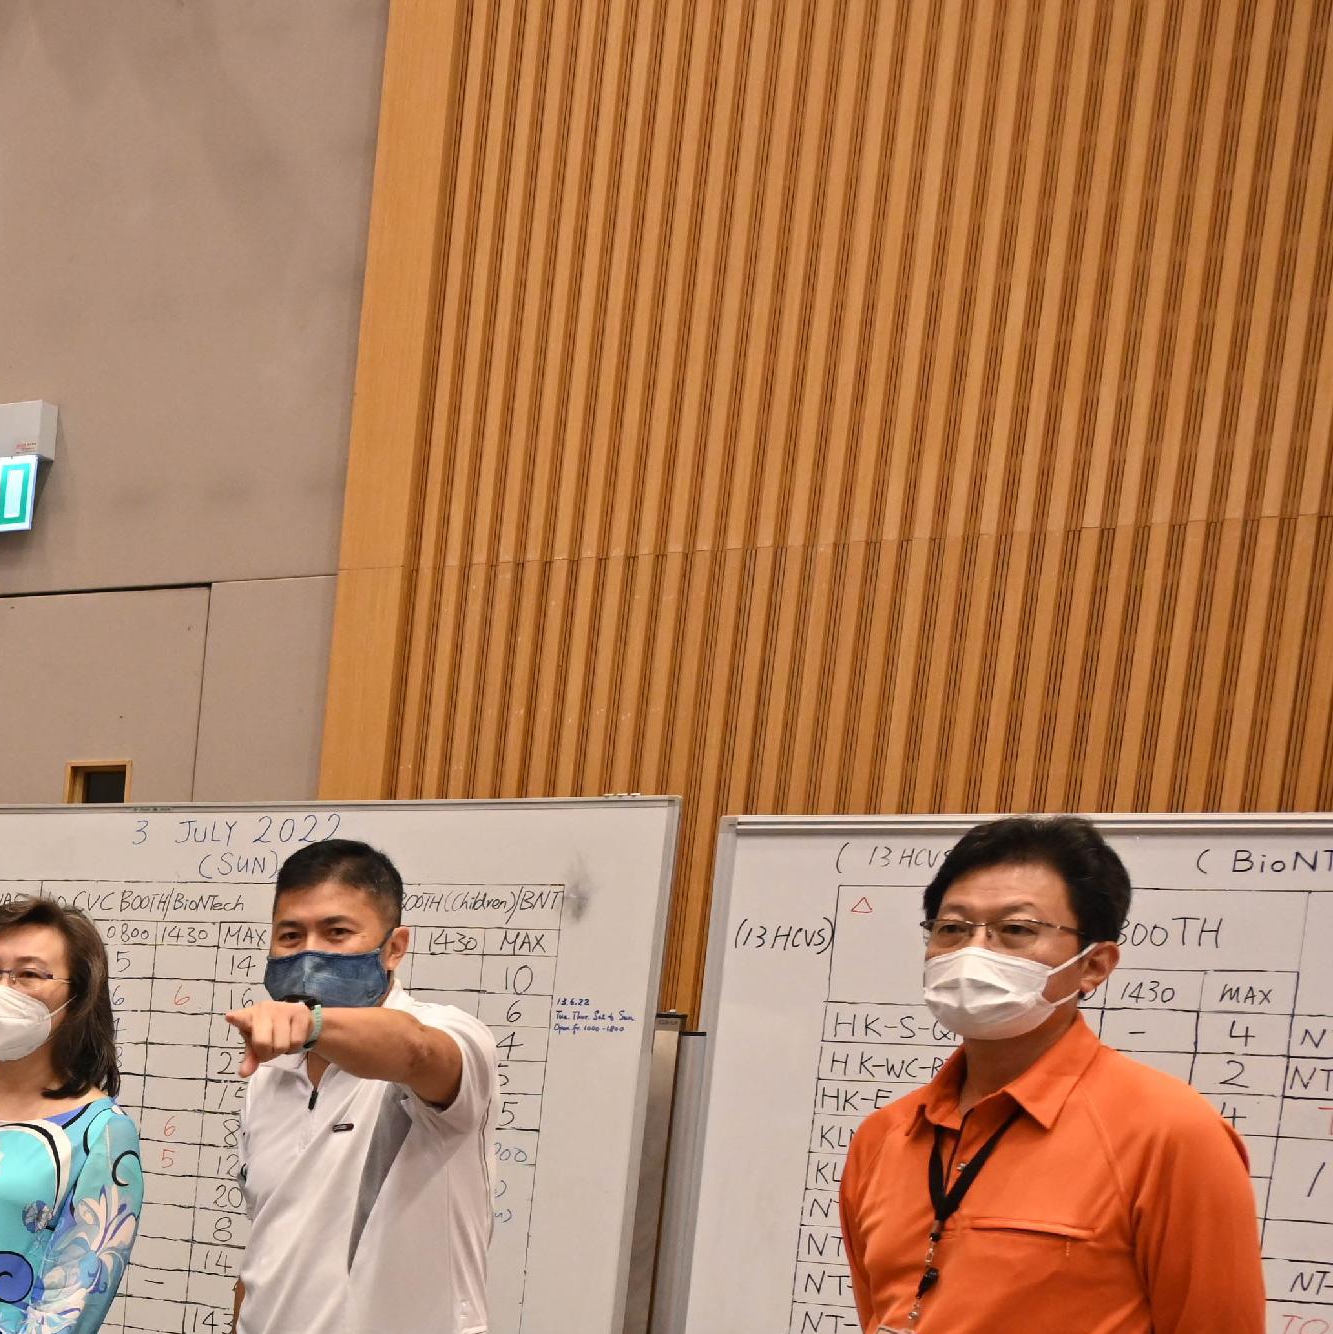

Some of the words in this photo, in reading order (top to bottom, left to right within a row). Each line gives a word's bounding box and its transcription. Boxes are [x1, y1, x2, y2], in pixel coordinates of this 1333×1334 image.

[132, 820, 149, 845] 3
[175, 820, 237, 846] JULY
[253, 813, 342, 843] 2022
[198, 850, 279, 879] (SUN)
[107, 923, 150, 943] 0800
[162, 925, 208, 943] 1430
[224, 925, 266, 946] MAX
[428, 929, 478, 952] 1430
[500, 931, 546, 956] MAX
[116, 951, 131, 972] 5
[230, 954, 256, 977] 14
[505, 965, 533, 995] 10
[1121, 980, 1175, 1003] 1430
[112, 985, 125, 1006] 6
[174, 985, 190, 1006] 6
[229, 988, 254, 1010] 16
[507, 1000, 521, 1023] 6
[496, 1031, 524, 1059] 4
[1229, 1020, 1256, 1047] 4
[1219, 1060, 1249, 1088] 2
[501, 1101, 519, 1126] 5
[164, 1115, 176, 1137] 6
[223, 1119, 241, 1147] 8
[161, 1149, 175, 1169] 5
[217, 1154, 239, 1178] 12
[213, 1184, 243, 1208] 20
[213, 1216, 232, 1242] 8
[204, 1250, 232, 1274] 14
[193, 1308, 233, 1334] 143
